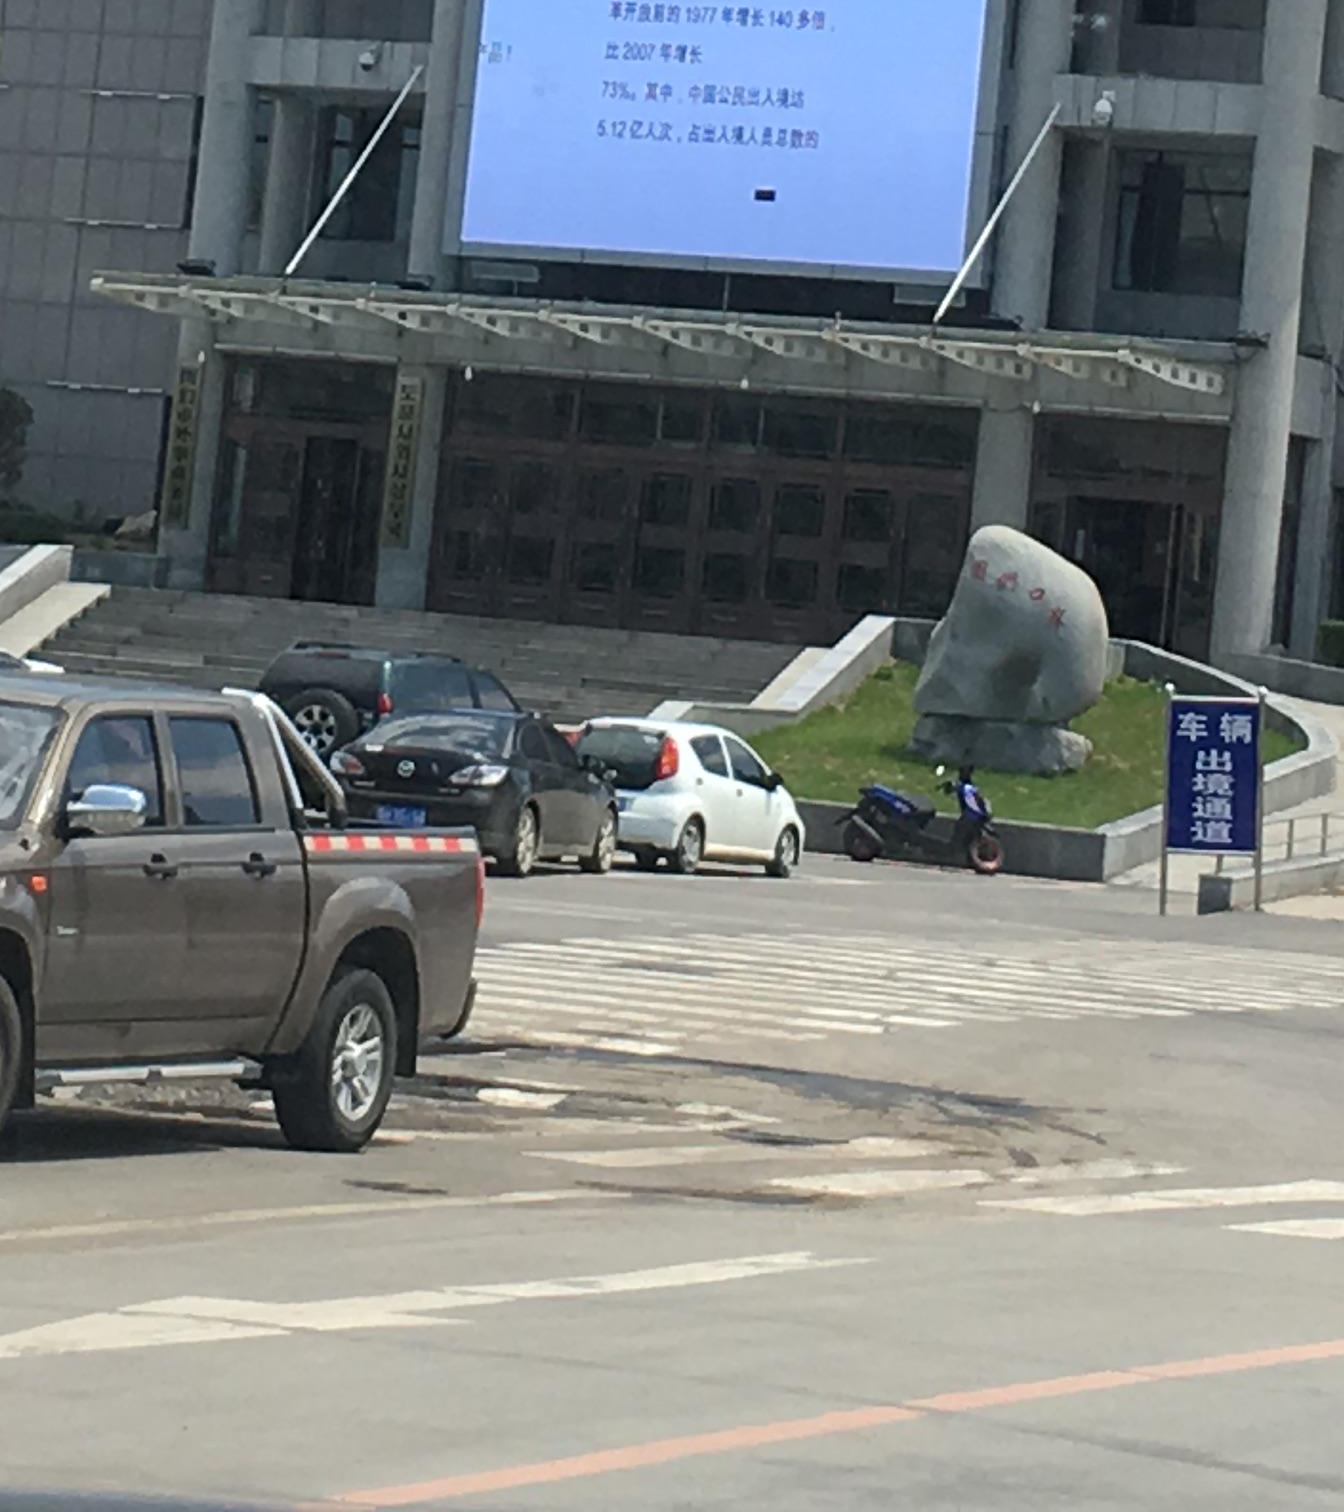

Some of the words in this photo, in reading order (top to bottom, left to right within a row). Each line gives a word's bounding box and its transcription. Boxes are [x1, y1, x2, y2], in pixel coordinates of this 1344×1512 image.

[1176, 712, 1253, 744] 车辆
[1189, 748, 1235, 844] 出境通道
